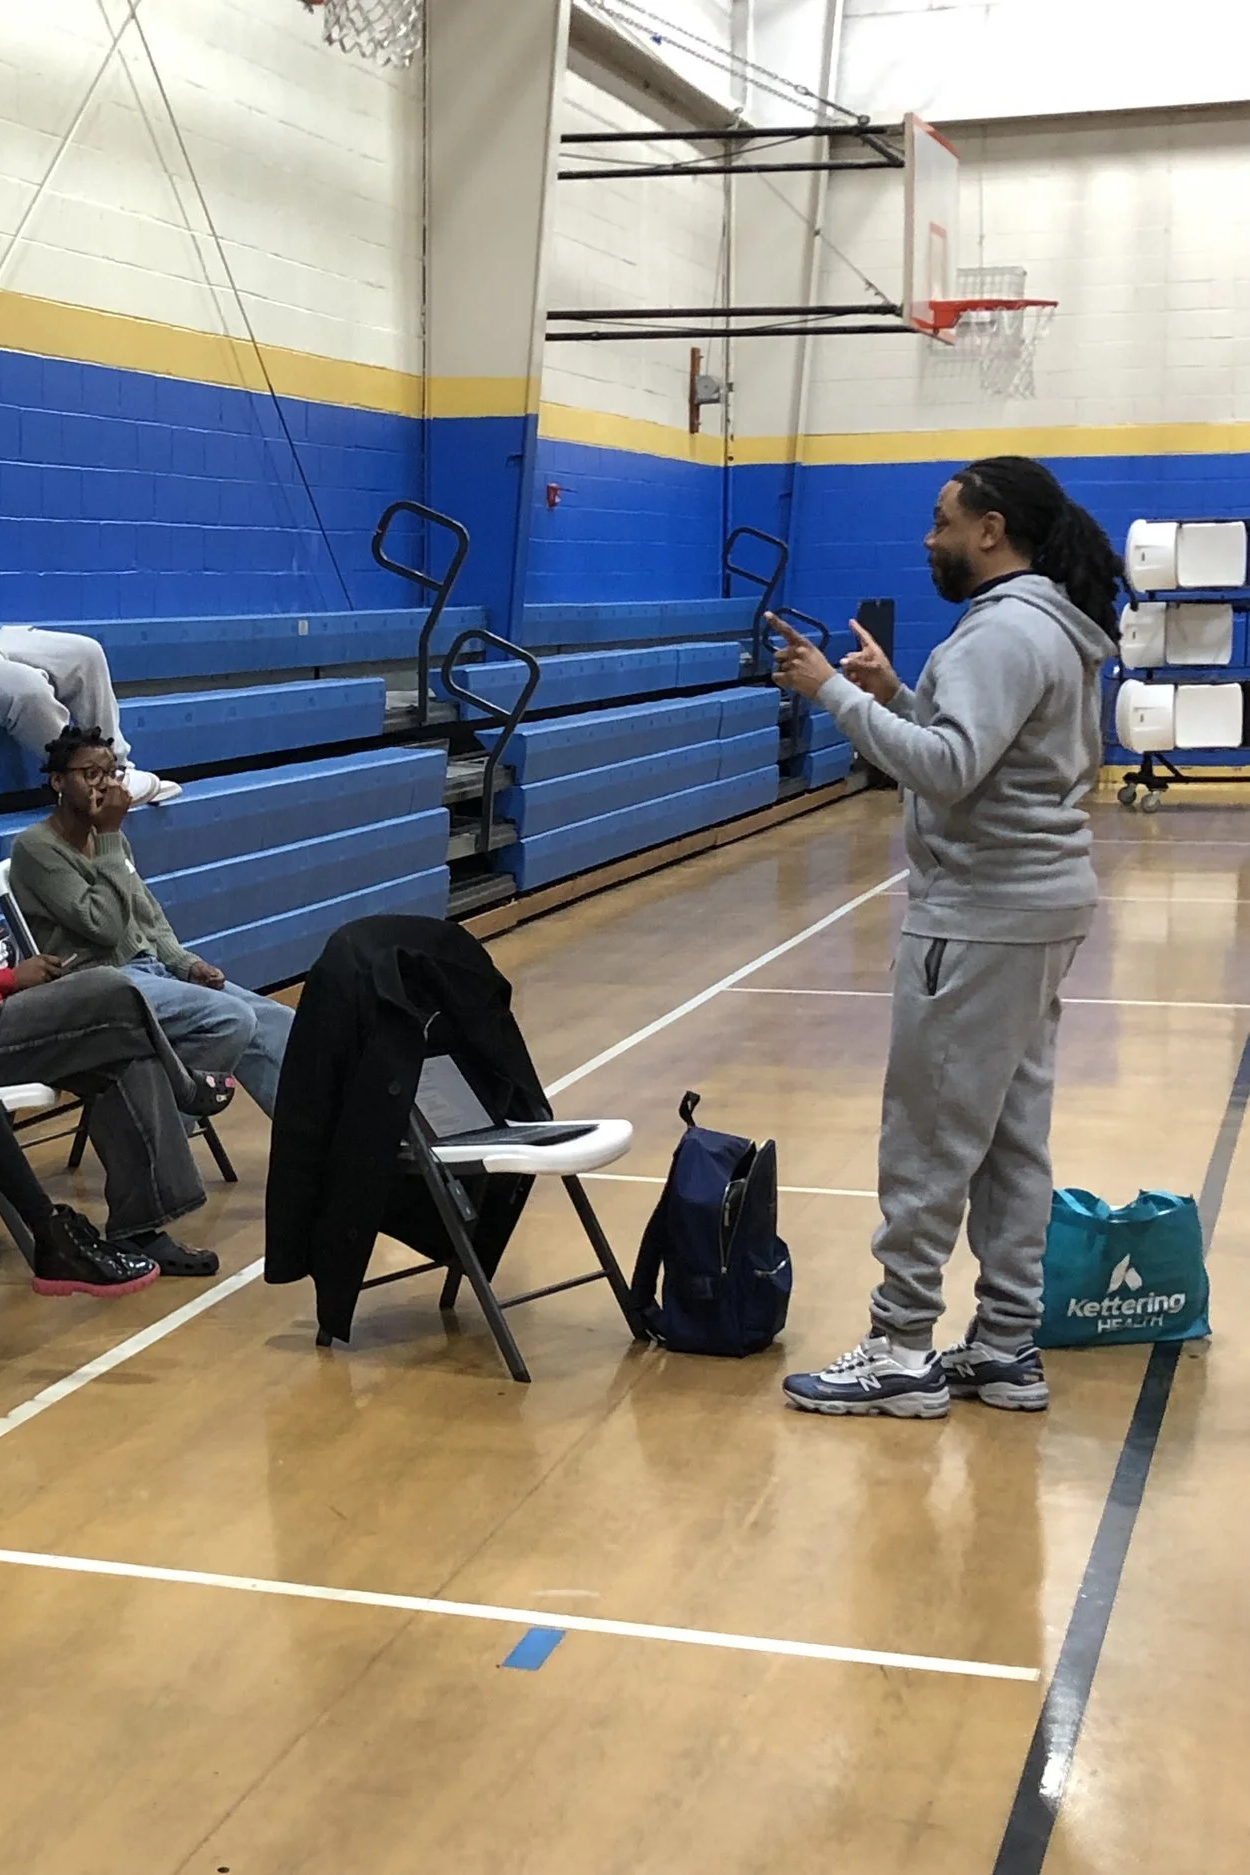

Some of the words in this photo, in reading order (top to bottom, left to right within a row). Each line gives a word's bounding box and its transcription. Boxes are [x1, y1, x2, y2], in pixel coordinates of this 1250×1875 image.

[1067, 1292, 1186, 1317] Kettering
[1097, 1314, 1164, 1333] HEALTH
[857, 1373, 882, 1392] N
